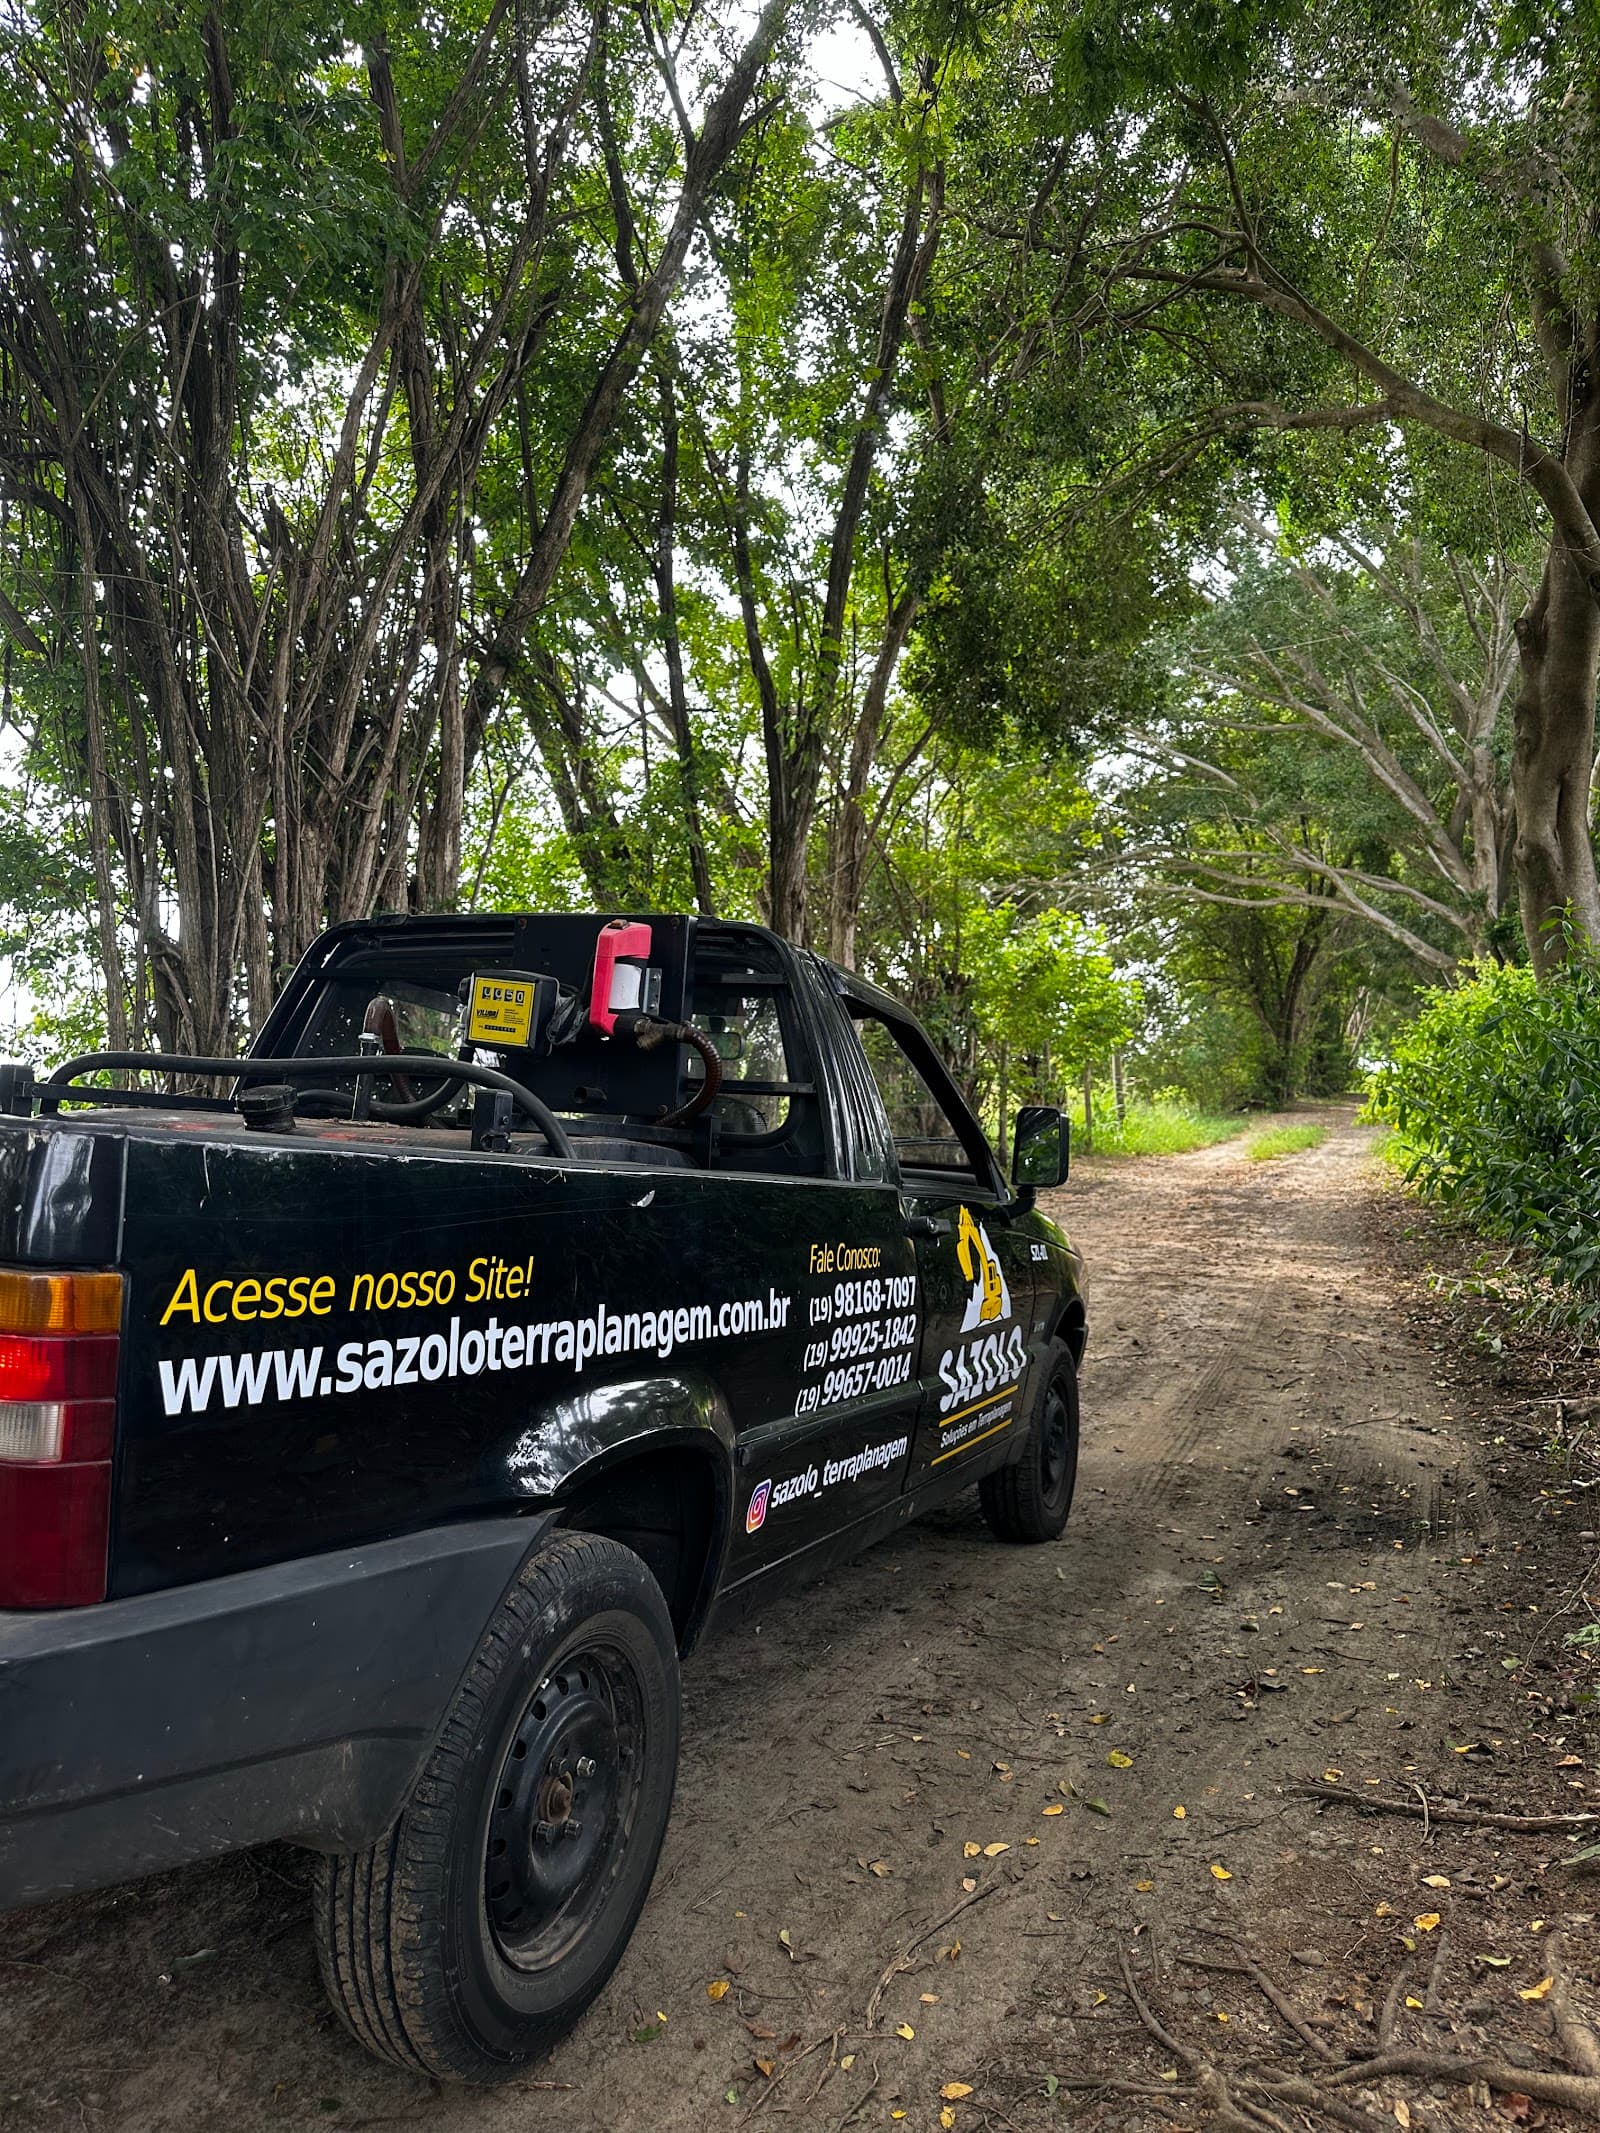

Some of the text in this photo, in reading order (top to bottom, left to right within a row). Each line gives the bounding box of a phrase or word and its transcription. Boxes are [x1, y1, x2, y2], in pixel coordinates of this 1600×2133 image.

[160, 1255, 534, 1325] Acesse nosso Site!
[809, 1242, 881, 1274] Fale Conosco:
[809, 1275, 917, 1326] (19) 98168-7097
[158, 1287, 791, 1416] www.sazoloterraplanagem.com.br
[803, 1313, 917, 1372] (19) 99925-1842
[939, 1324, 1027, 1413] SAZOLO
[795, 1352, 911, 1418] (19) 99657-0014
[770, 1436, 908, 1509] sazolo_terraplanagem
